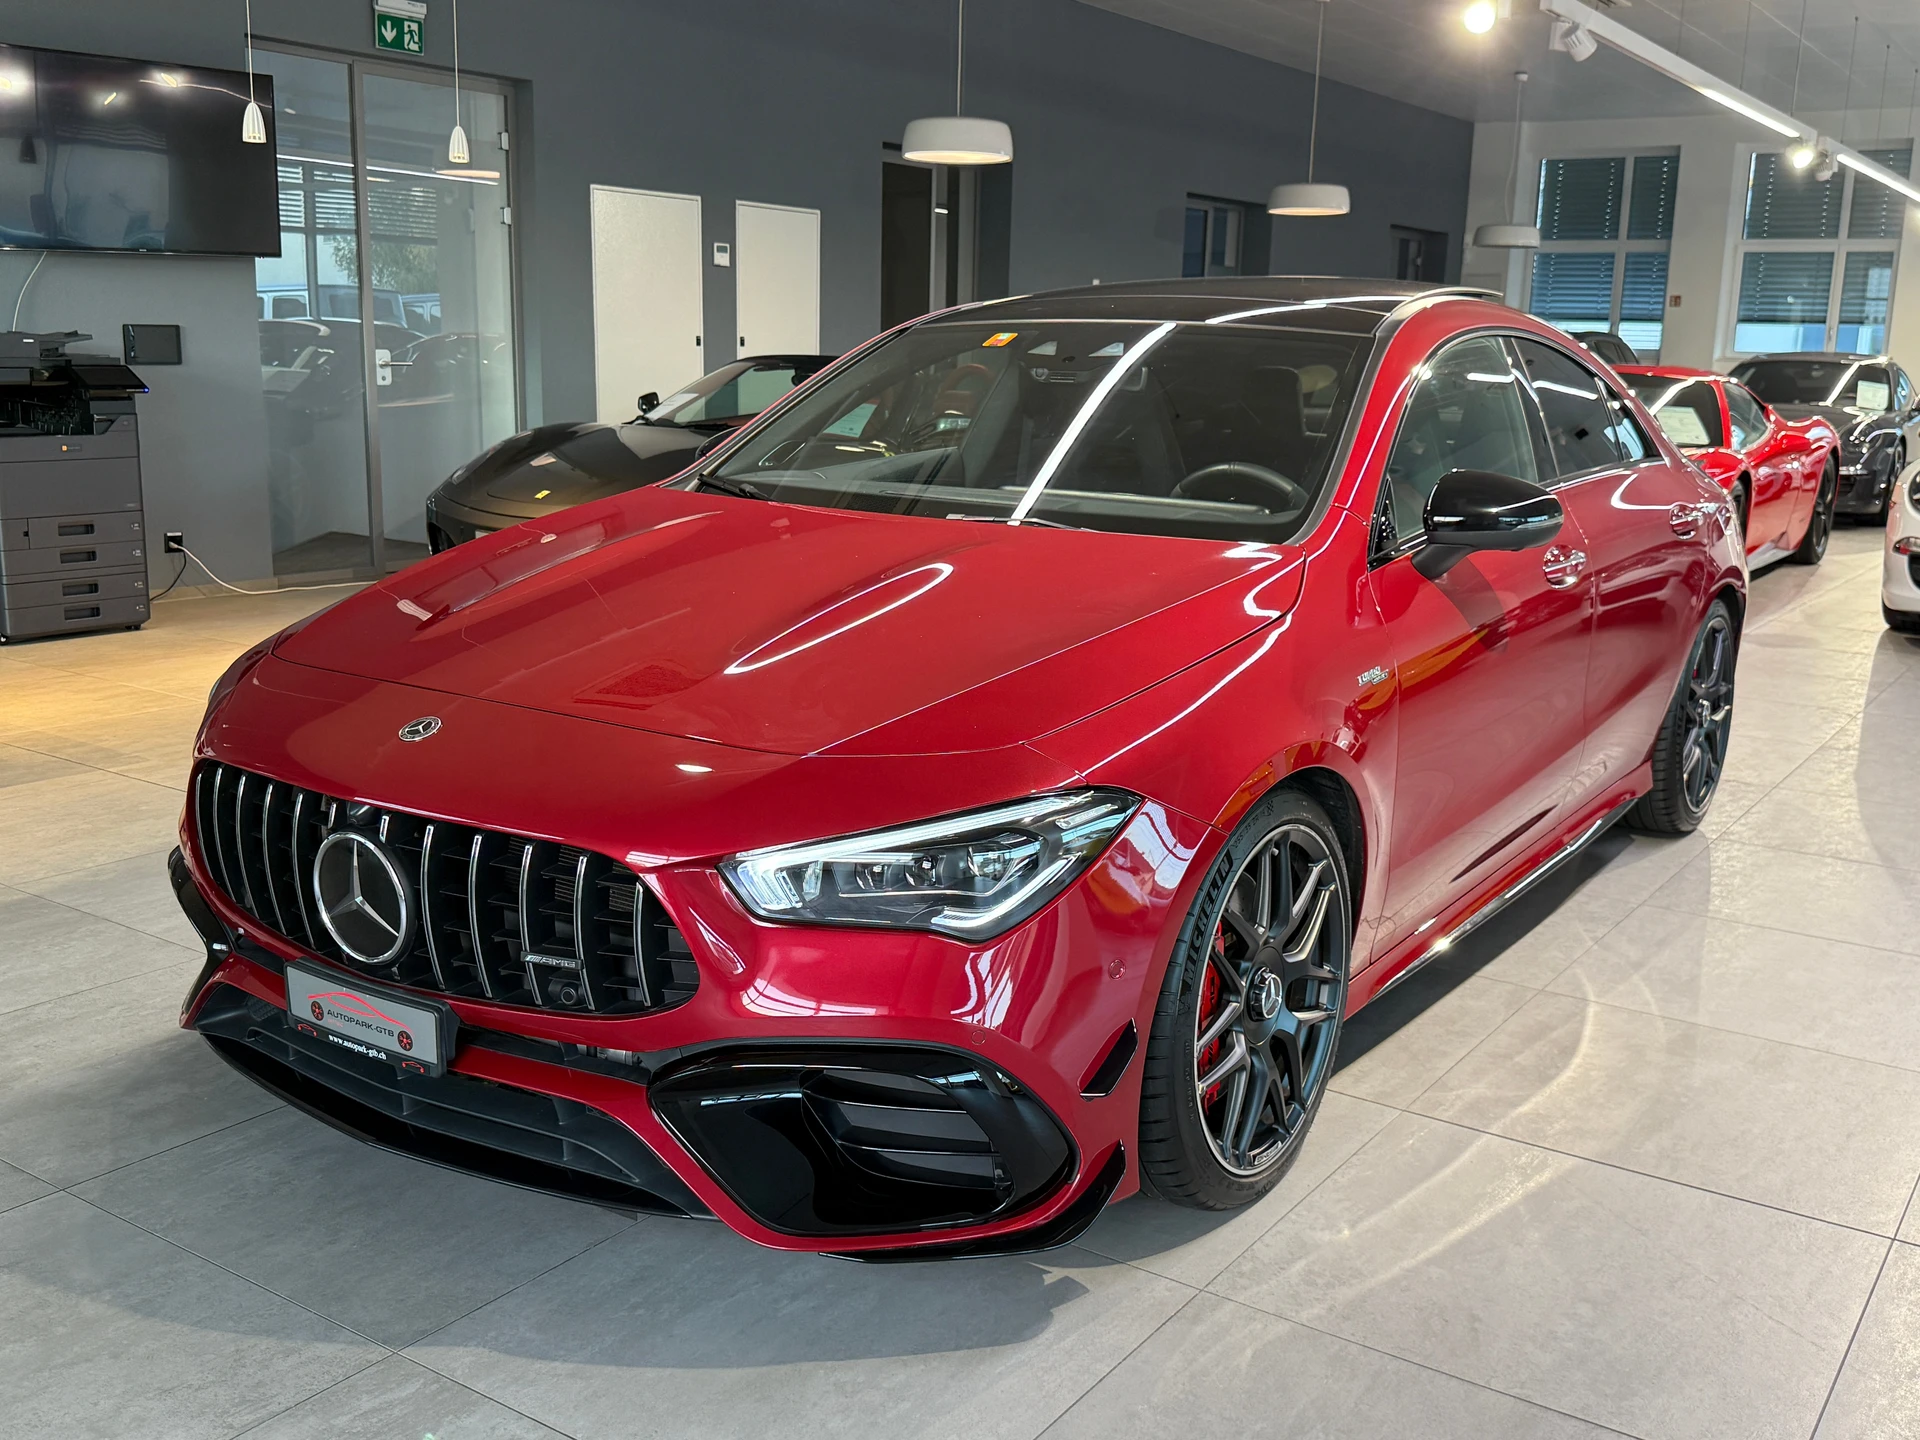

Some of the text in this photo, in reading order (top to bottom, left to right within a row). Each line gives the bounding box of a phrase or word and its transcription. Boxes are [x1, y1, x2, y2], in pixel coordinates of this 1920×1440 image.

[1183, 853, 1231, 988] MICHELIN
[540, 956, 575, 968] AMG
[327, 1009, 395, 1037] AUTOPARK-GTB
[328, 1034, 387, 1061] www.autopark-gtb.ch
